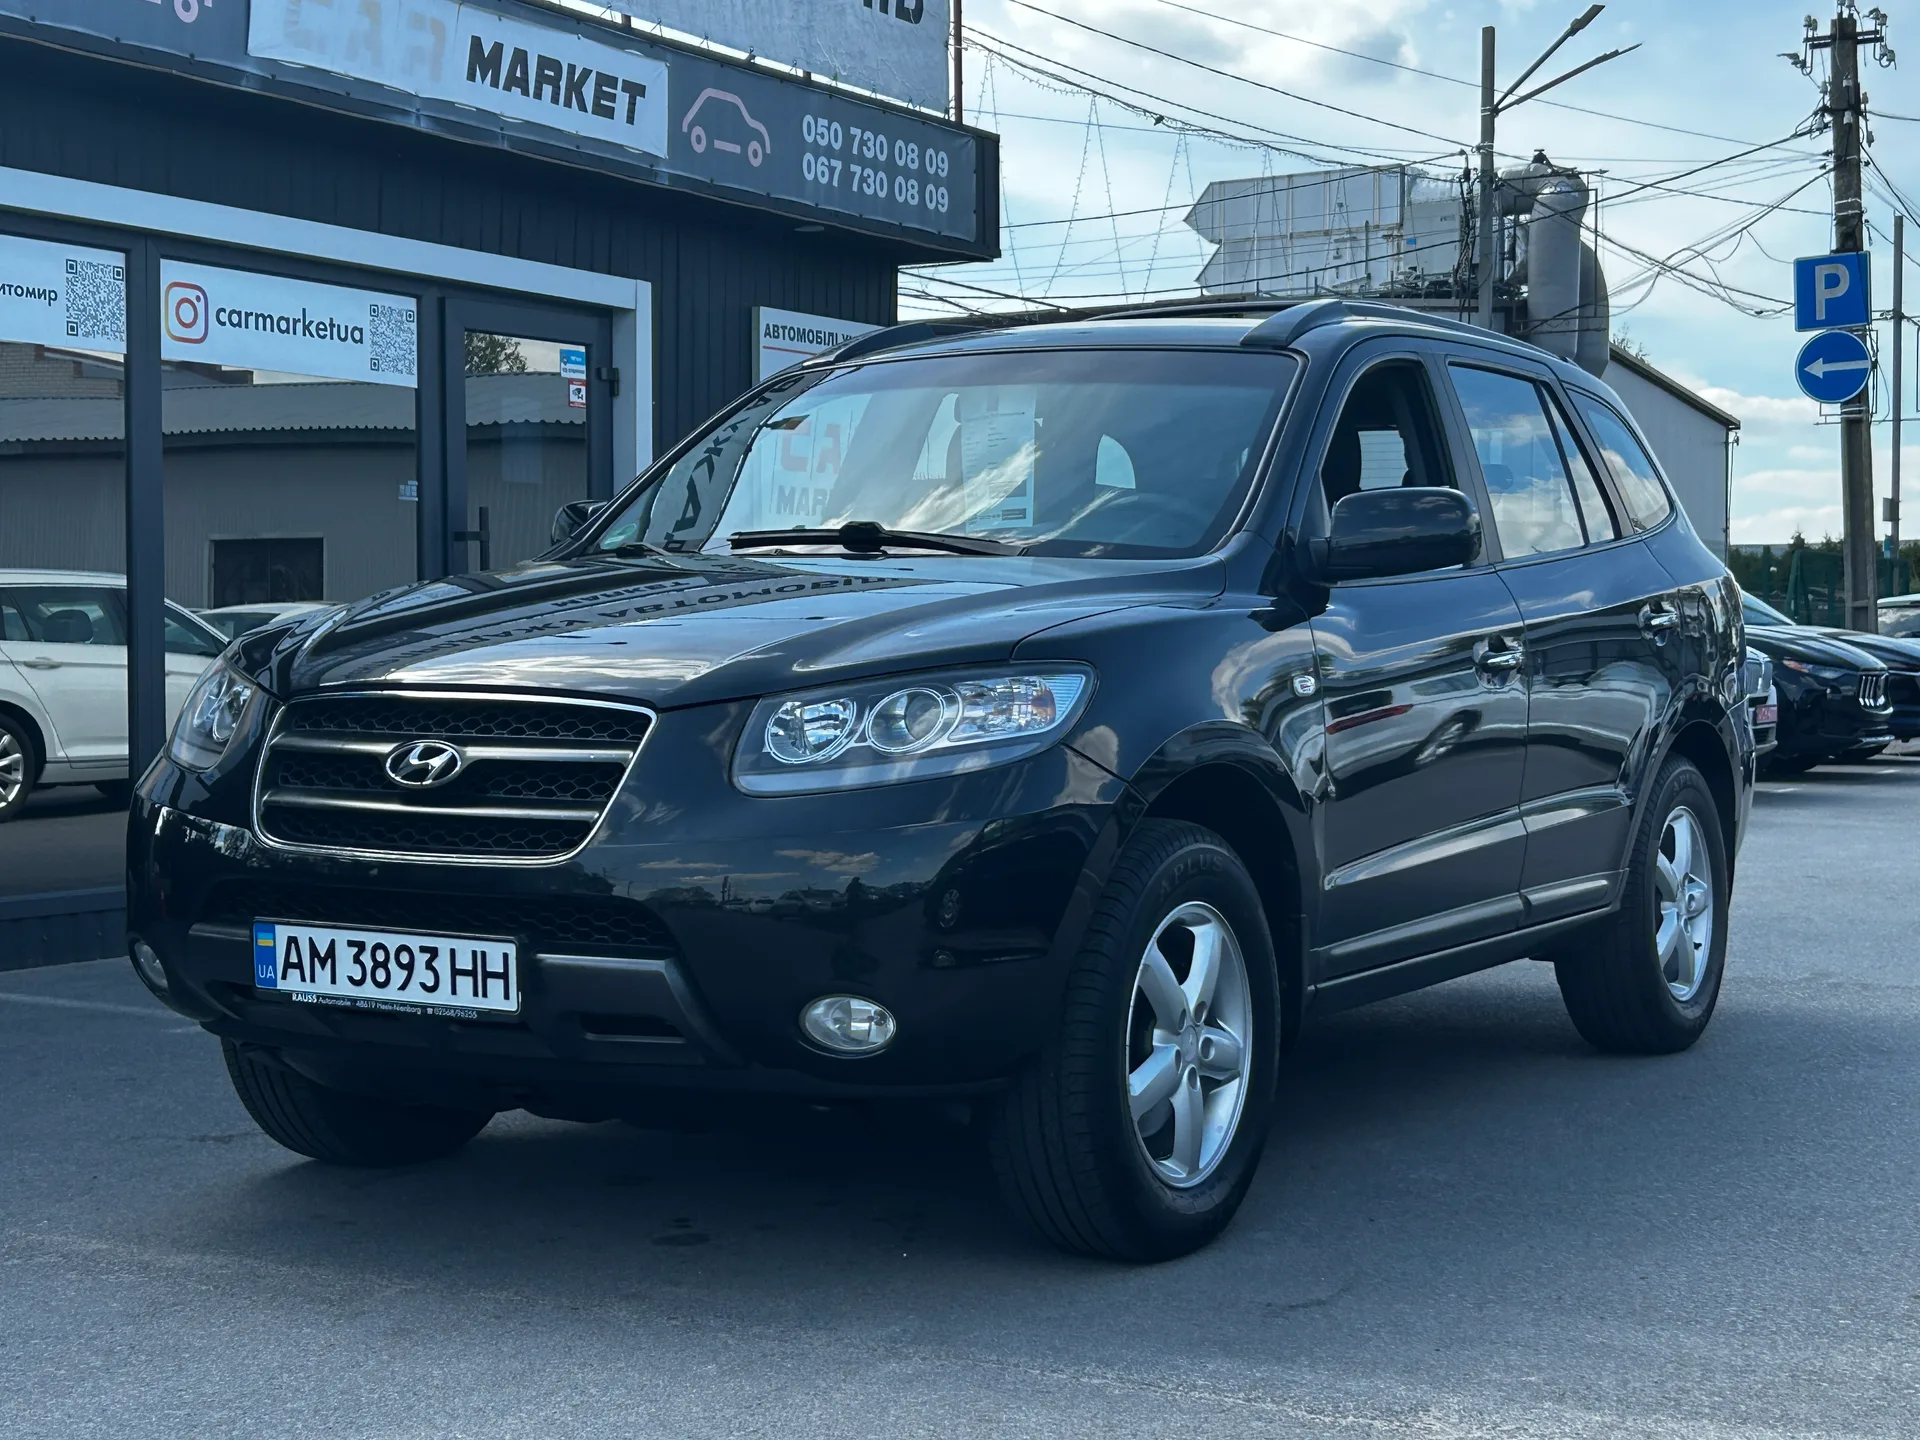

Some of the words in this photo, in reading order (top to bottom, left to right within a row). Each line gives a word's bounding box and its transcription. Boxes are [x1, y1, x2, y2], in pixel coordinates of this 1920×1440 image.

[466, 34, 647, 126] MARKET
[802, 114, 842, 150] 050
[849, 127, 888, 161] 730
[894, 139, 920, 170] 08
[924, 148, 949, 178] 09
[802, 152, 842, 188] 067
[849, 164, 888, 199] 730
[894, 175, 920, 206] 08
[924, 184, 949, 213] 09
[1814, 263, 1851, 321] P
[216, 306, 363, 345] carmarketua
[764, 323, 838, 346] АВТОМОБІЛІ
[780, 419, 842, 474] CA
[775, 485, 830, 517] MAR
[257, 964, 275, 979] UA
[280, 935, 337, 985] AM
[346, 939, 440, 993] 3893
[450, 948, 510, 1000] HH
[292, 992, 318, 1004] RAUSS
